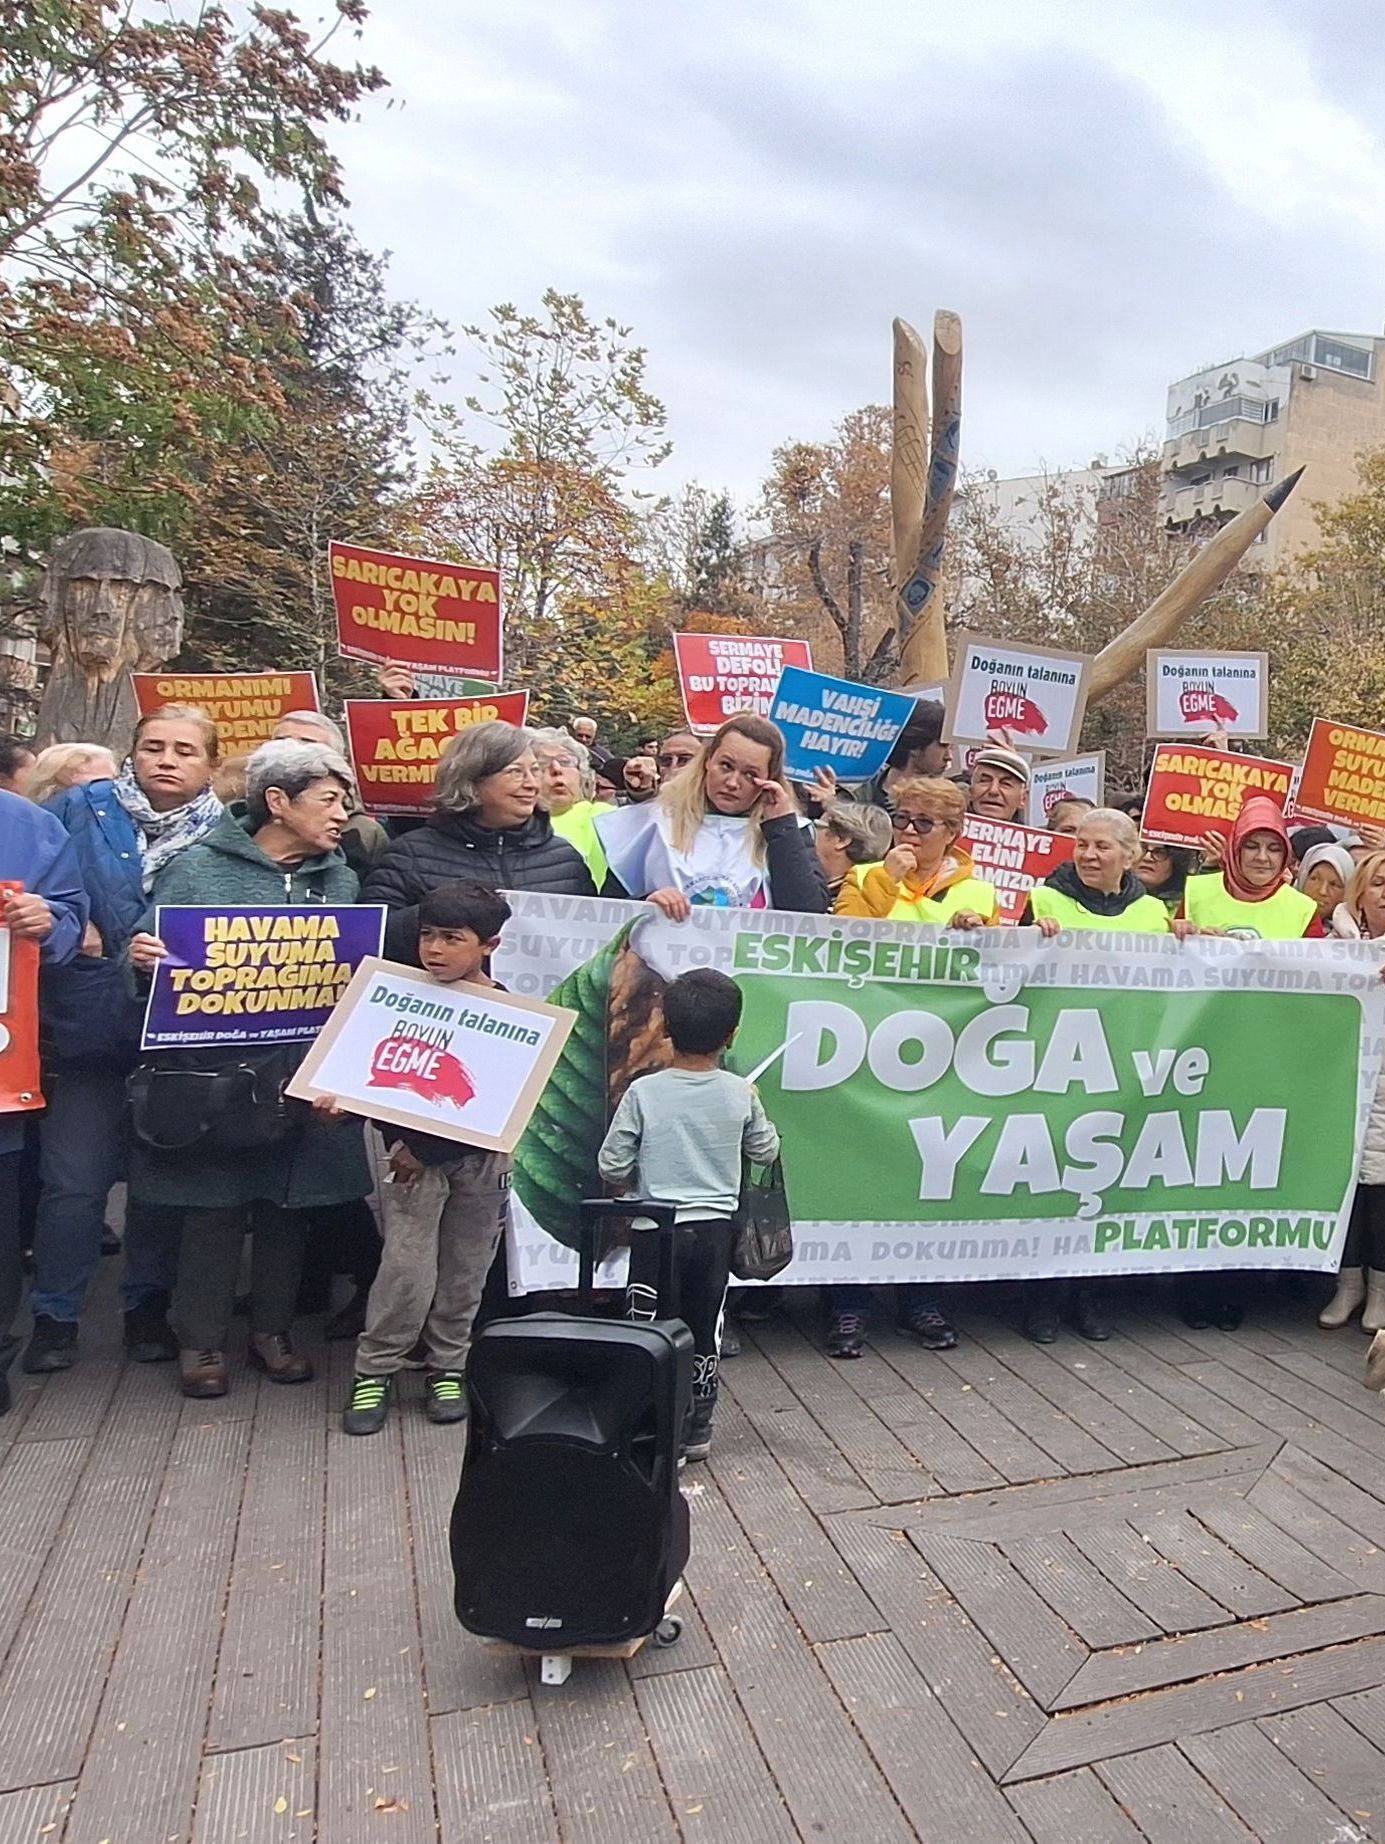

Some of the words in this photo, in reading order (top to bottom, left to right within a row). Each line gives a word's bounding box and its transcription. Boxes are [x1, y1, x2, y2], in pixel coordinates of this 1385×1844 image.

[332, 555, 497, 603] SARICAKAYA
[383, 589, 438, 618] YOK
[352, 606, 476, 645] OLMASIN!
[708, 640, 783, 658] SERMAYE
[716, 657, 781, 677] DEFOL!
[971, 656, 1024, 677] Doğanın
[1027, 665, 1076, 685] talanına
[1163, 665, 1208, 678] Doğanın
[1212, 666, 1256, 679] talanına
[156, 678, 292, 698] ORMANIMI
[689, 676, 715, 692] BU
[716, 676, 780, 692] TOPRA
[990, 679, 1028, 698] BOYUN
[1182, 681, 1215, 694] BOYUN
[822, 689, 882, 720] VAHŞİ
[391, 708, 449, 734] TEK
[775, 700, 899, 741] MADENCİLİĞE
[800, 730, 869, 760] HAYIR!
[1155, 753, 1288, 793] SARICAKAYA
[1200, 778, 1248, 803] YOK
[1165, 793, 1242, 822] OLMAS
[962, 819, 1053, 854] SERMAYE
[971, 843, 1026, 870] ELİNİ
[204, 915, 340, 941] HAVAMA
[205, 940, 336, 968] SUYUMA
[733, 929, 981, 988] ESKİŞEHİR
[1204, 967, 1322, 990] SUYUMA
[170, 961, 352, 991] TOPRAĞIMA
[176, 985, 345, 1015] DOKUNMA!
[370, 985, 455, 1022] Doğanın
[457, 1008, 541, 1046] talanına
[391, 1019, 454, 1050] BOYUN
[782, 979, 1117, 1097] DOĞA
[1133, 1037, 1211, 1098] ve
[376, 1041, 444, 1080] EĞME
[907, 1107, 1287, 1217] YAŞAM
[871, 1237, 1040, 1262] DOKUNMA!
[1094, 1217, 1337, 1253] PLATFORMU
